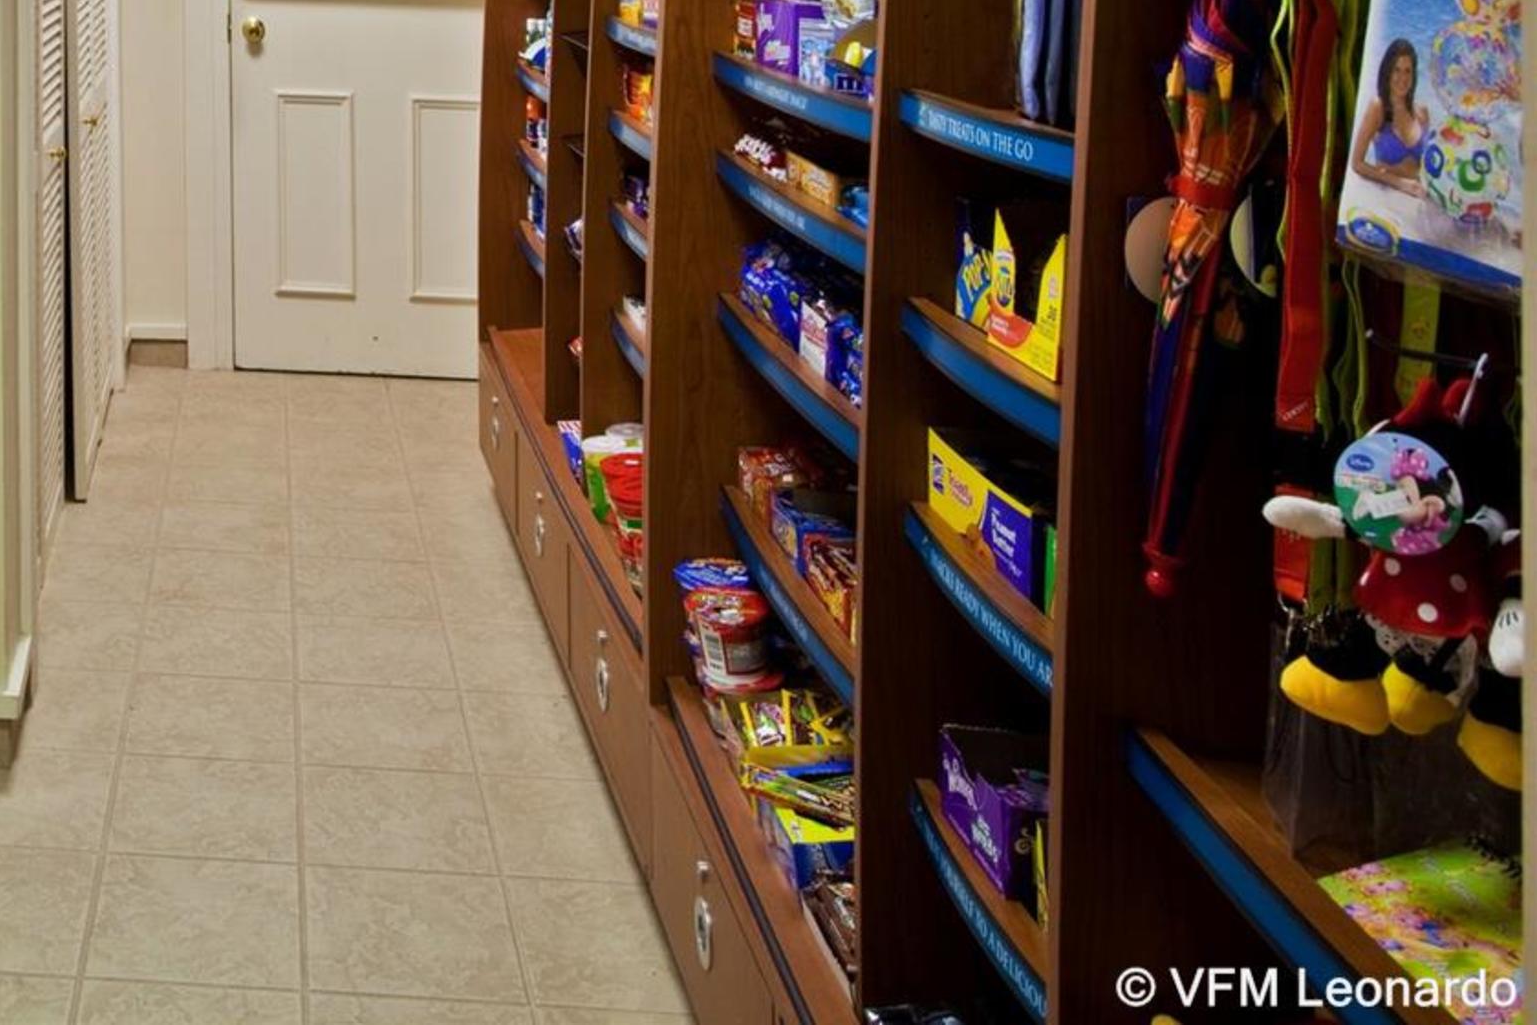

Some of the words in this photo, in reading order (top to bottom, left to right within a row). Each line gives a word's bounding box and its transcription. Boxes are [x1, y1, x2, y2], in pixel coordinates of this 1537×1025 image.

[976, 128, 991, 148] ON
[993, 131, 1012, 156] THE
[1014, 138, 1034, 162] GO
[1011, 634, 1036, 672] YOU
[1036, 659, 1054, 688] AR
[995, 944, 1048, 1019] DELICIOU
